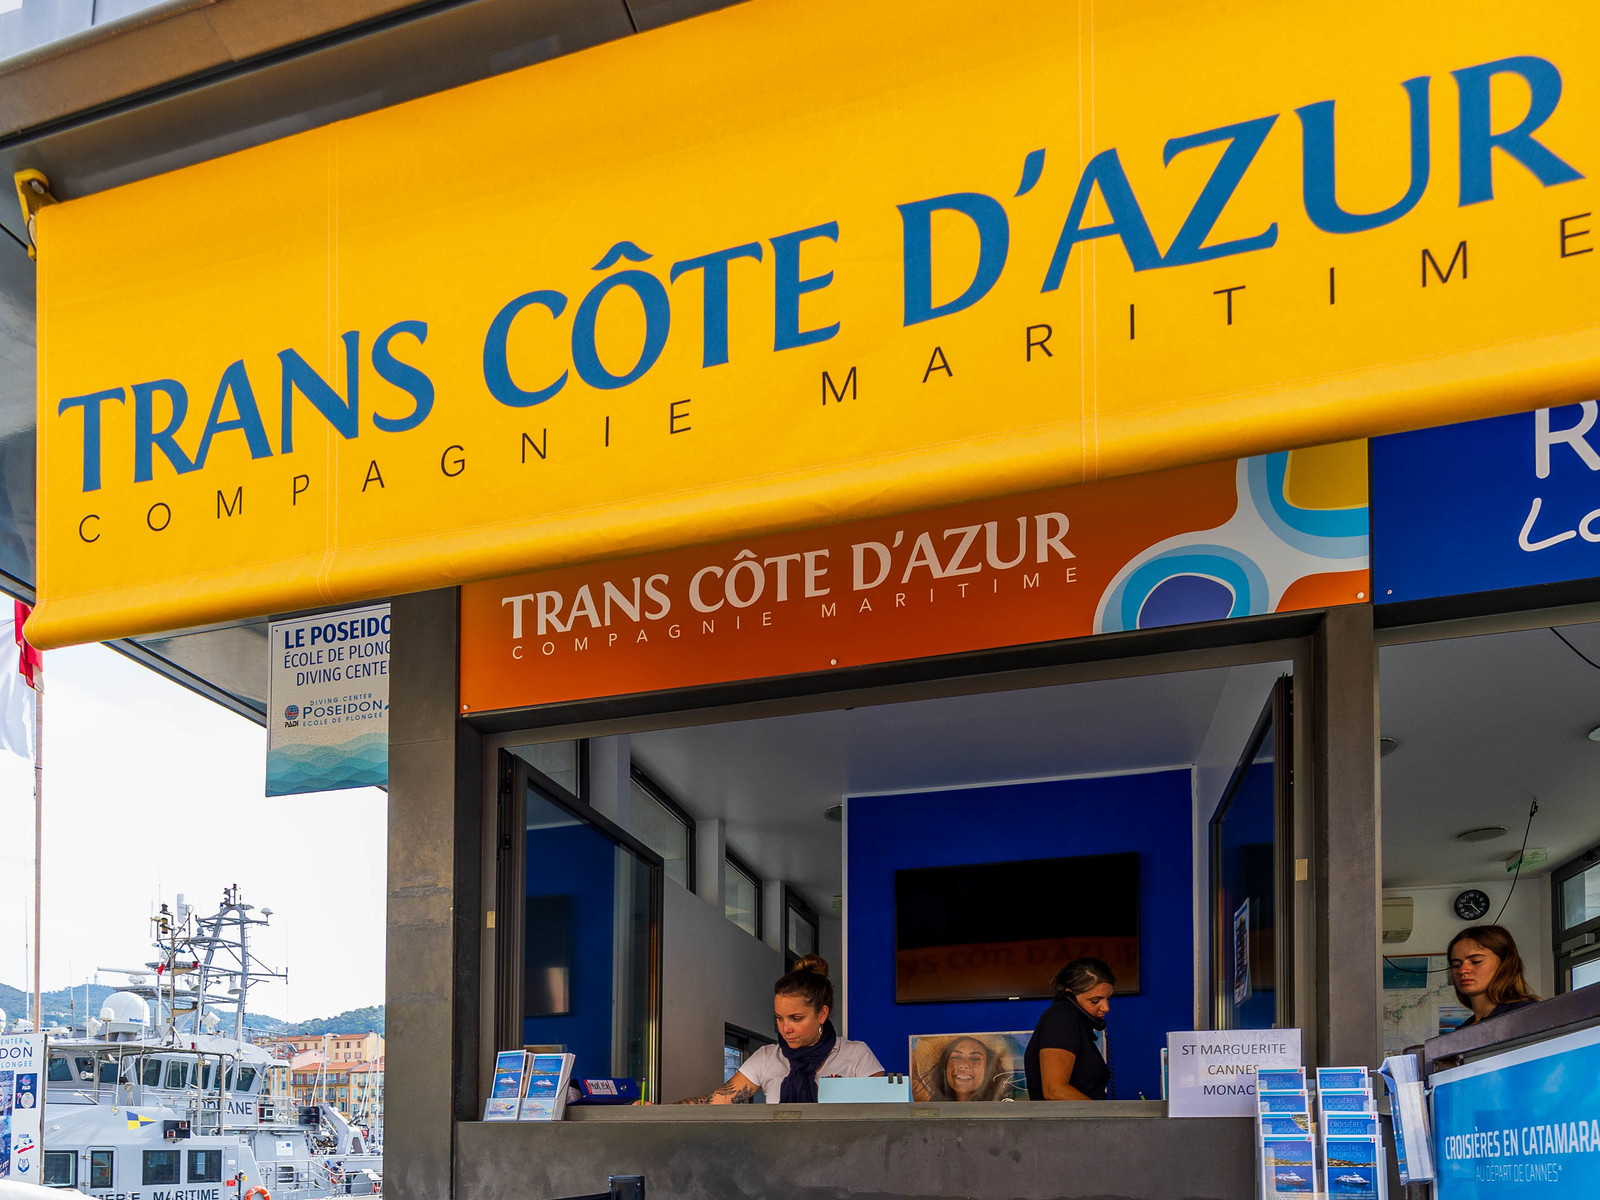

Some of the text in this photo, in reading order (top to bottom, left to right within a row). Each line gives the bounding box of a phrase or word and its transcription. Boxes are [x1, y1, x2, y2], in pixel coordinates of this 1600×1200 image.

[58, 55, 1586, 493] TRANS CÔTE D'AZUR
[78, 212, 1595, 544] COMPAGNIE MARITIME
[501, 512, 1076, 639] TRANS CÔTE D'AZUR
[512, 567, 1077, 660] COMPAGNIE MARITIME
[285, 628, 305, 650] LE
[284, 649, 323, 669] ÉCOLE
[328, 647, 344, 663] DE
[296, 660, 391, 687] DIVING CENTE
[302, 700, 383, 719] POSEIDON
[309, 692, 373, 707] DIVING CENTER
[302, 718, 329, 728] ECOLE
[332, 716, 342, 724] DE
[1182, 1043, 1287, 1055] ST MARGUERITE
[1445, 1126, 1500, 1160] CROISIÈRES
[1503, 1128, 1519, 1157] EN
[1475, 1165, 1485, 1182] AU
[1486, 1161, 1512, 1182] DÉPART
[1514, 1164, 1524, 1182] DE
